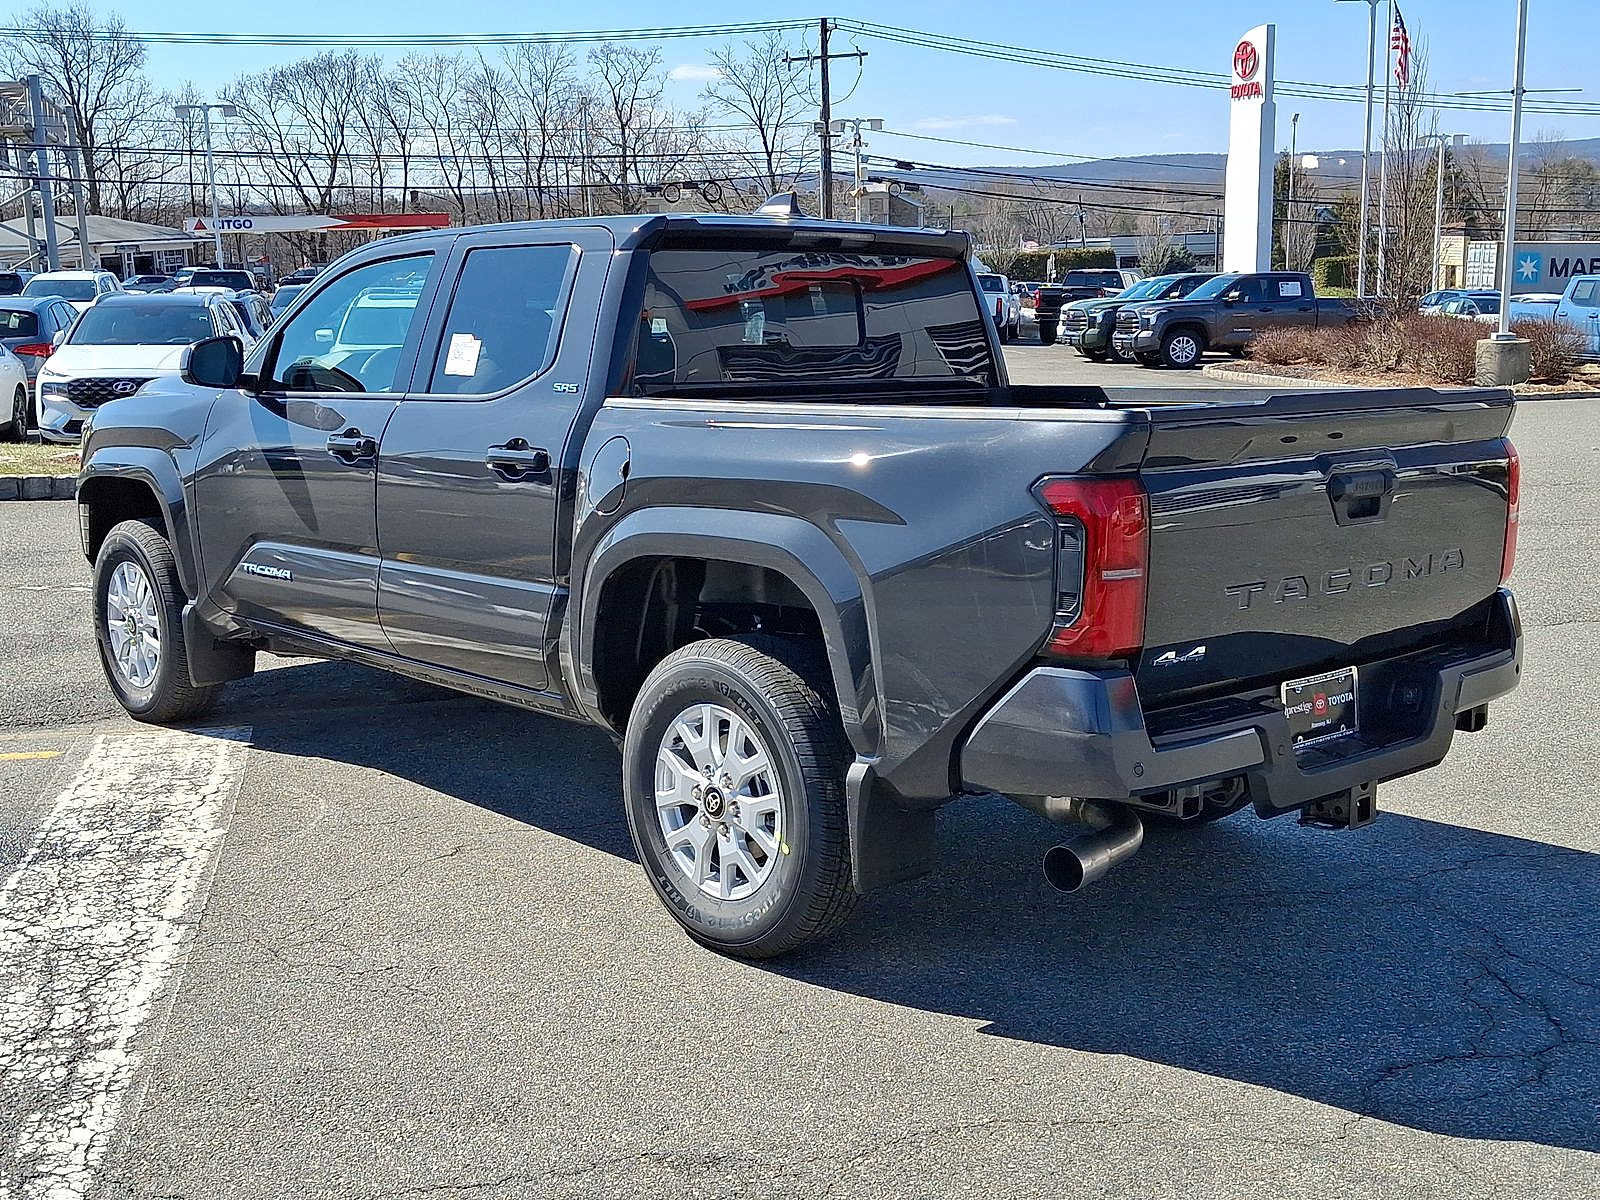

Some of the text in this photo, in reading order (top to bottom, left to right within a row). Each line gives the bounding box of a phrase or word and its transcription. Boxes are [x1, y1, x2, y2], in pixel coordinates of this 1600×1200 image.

[240, 562, 293, 581] TACOMA
[1225, 548, 1464, 610] TACOMA
[1285, 692, 1353, 718] prestige TOYOTA
